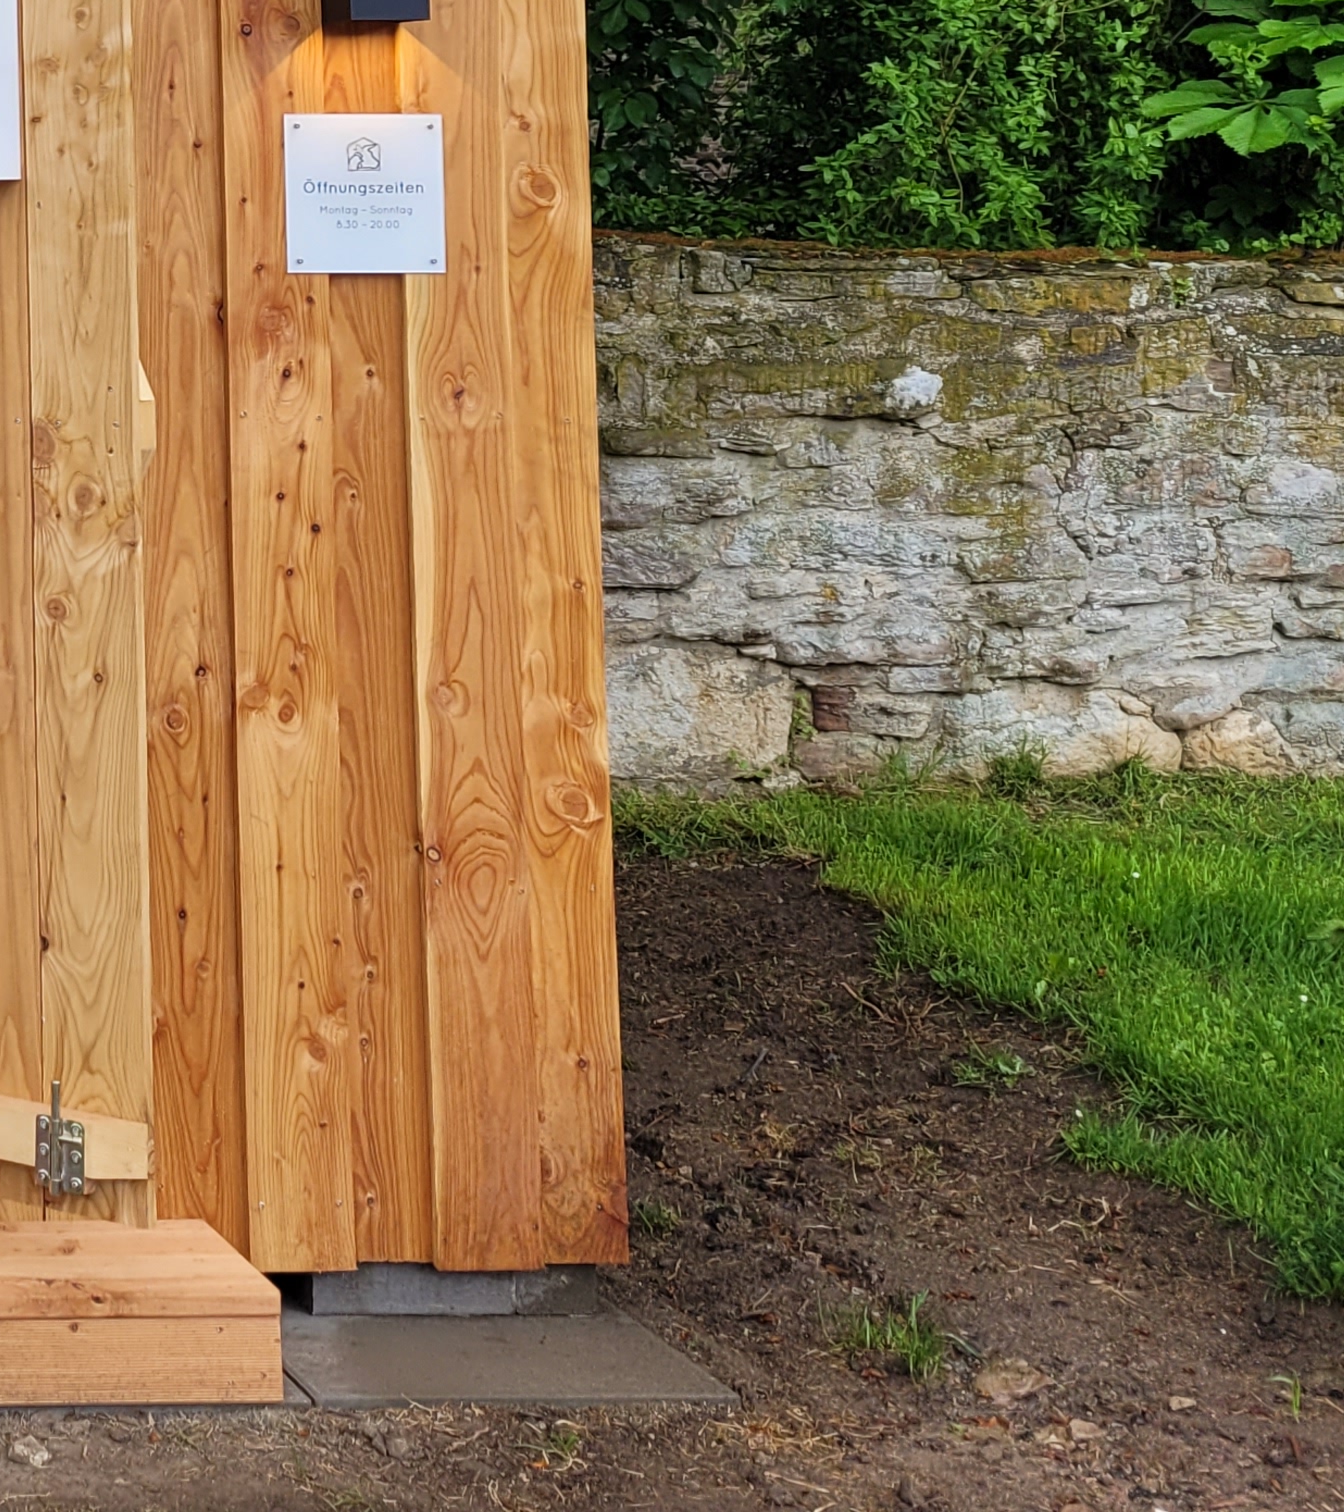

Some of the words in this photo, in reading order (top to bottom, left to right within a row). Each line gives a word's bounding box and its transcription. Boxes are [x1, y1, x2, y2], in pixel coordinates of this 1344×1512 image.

[303, 178, 425, 197] Öffnungszeiten
[319, 205, 359, 216] Montag
[369, 205, 414, 216] Sonntag
